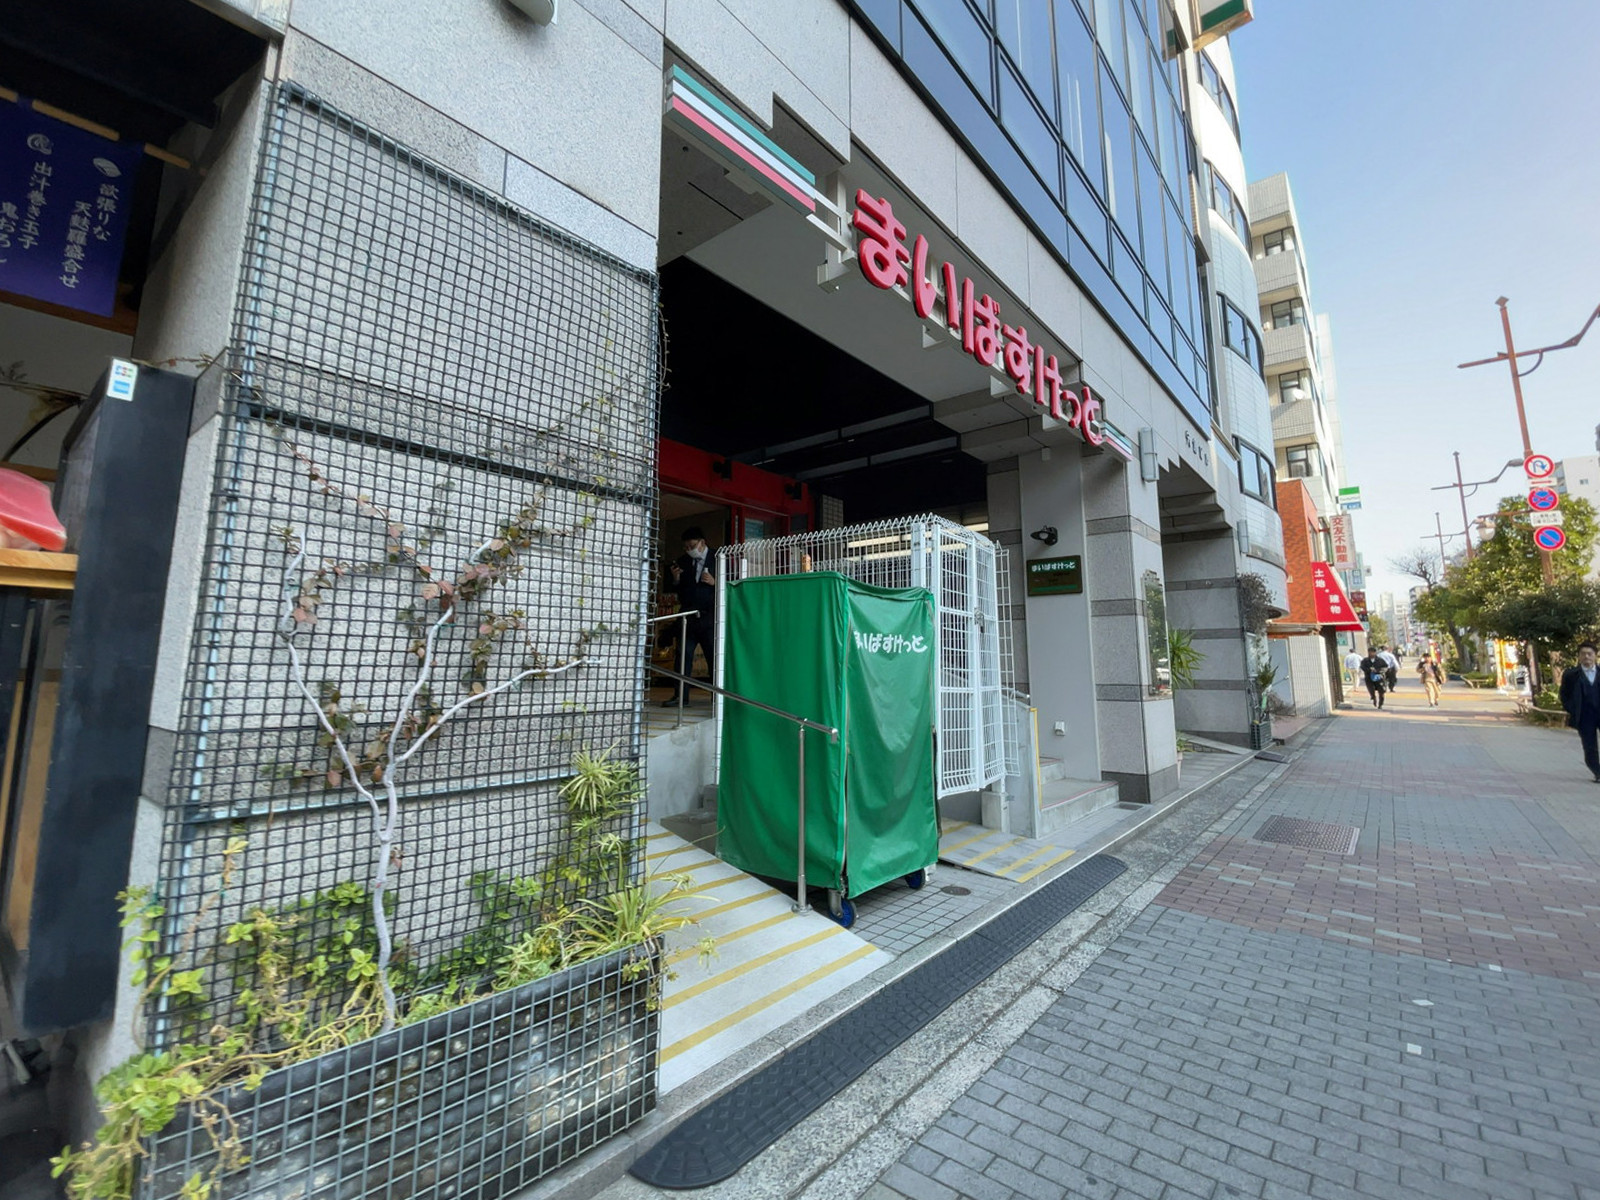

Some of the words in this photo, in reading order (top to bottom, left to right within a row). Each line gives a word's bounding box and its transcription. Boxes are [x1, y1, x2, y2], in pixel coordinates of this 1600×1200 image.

[854, 188, 1103, 446] まいばすけっと
[853, 630, 928, 653] いばすけっと
